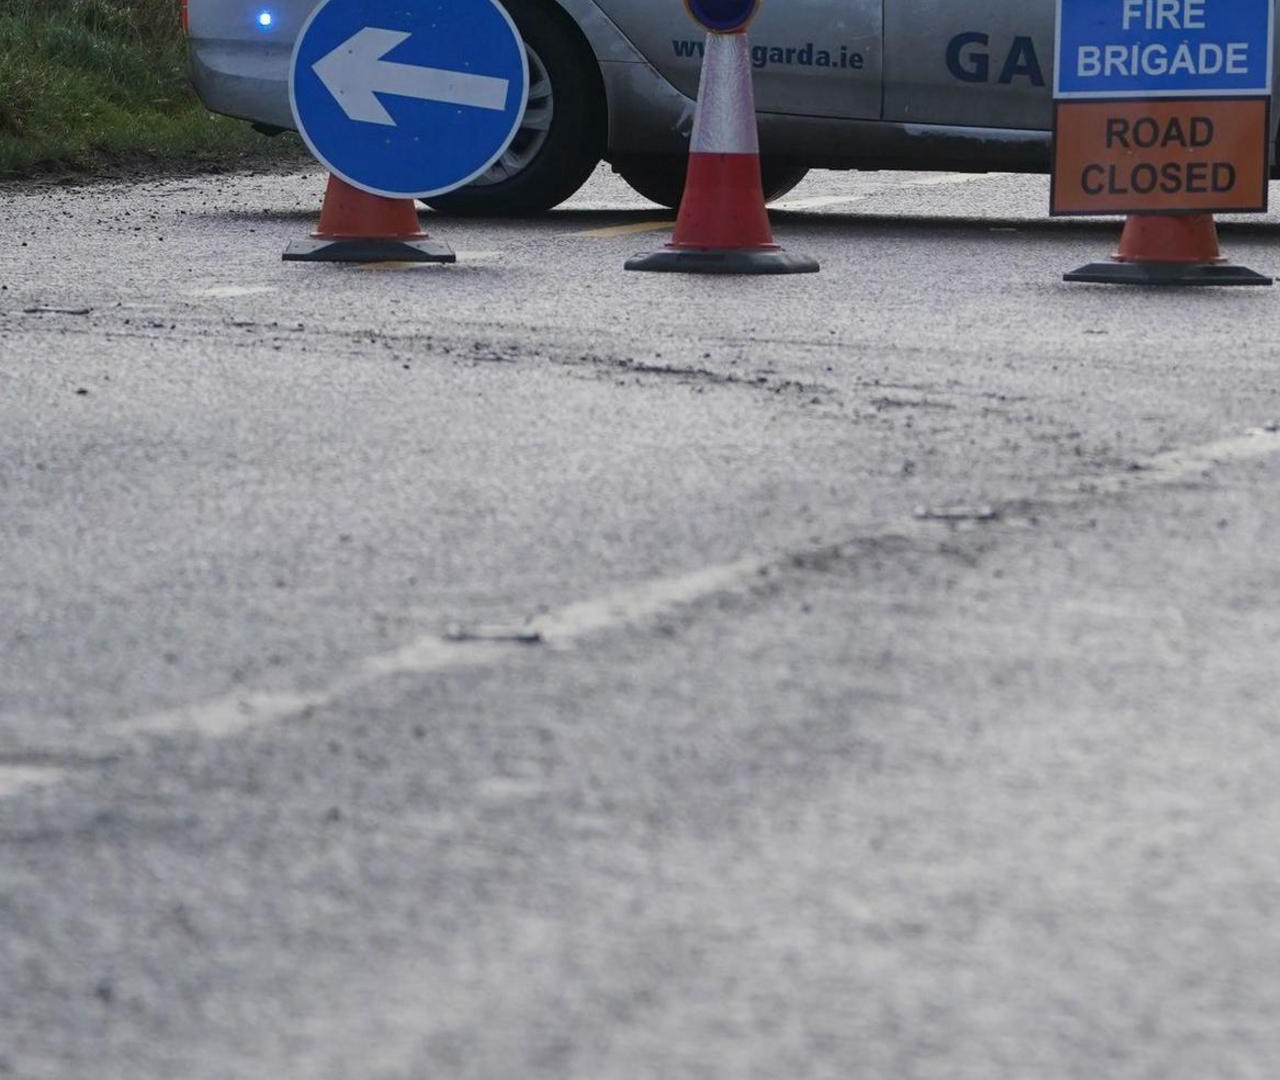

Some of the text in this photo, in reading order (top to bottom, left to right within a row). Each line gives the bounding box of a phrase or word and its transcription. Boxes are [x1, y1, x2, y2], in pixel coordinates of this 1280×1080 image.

[672, 38, 864, 71] wgarda.ie
[945, 31, 1045, 88] GA
[1076, 41, 1249, 78] BRIGADE
[1105, 115, 1214, 149] ROAD
[1080, 161, 1237, 195] CLOSED
